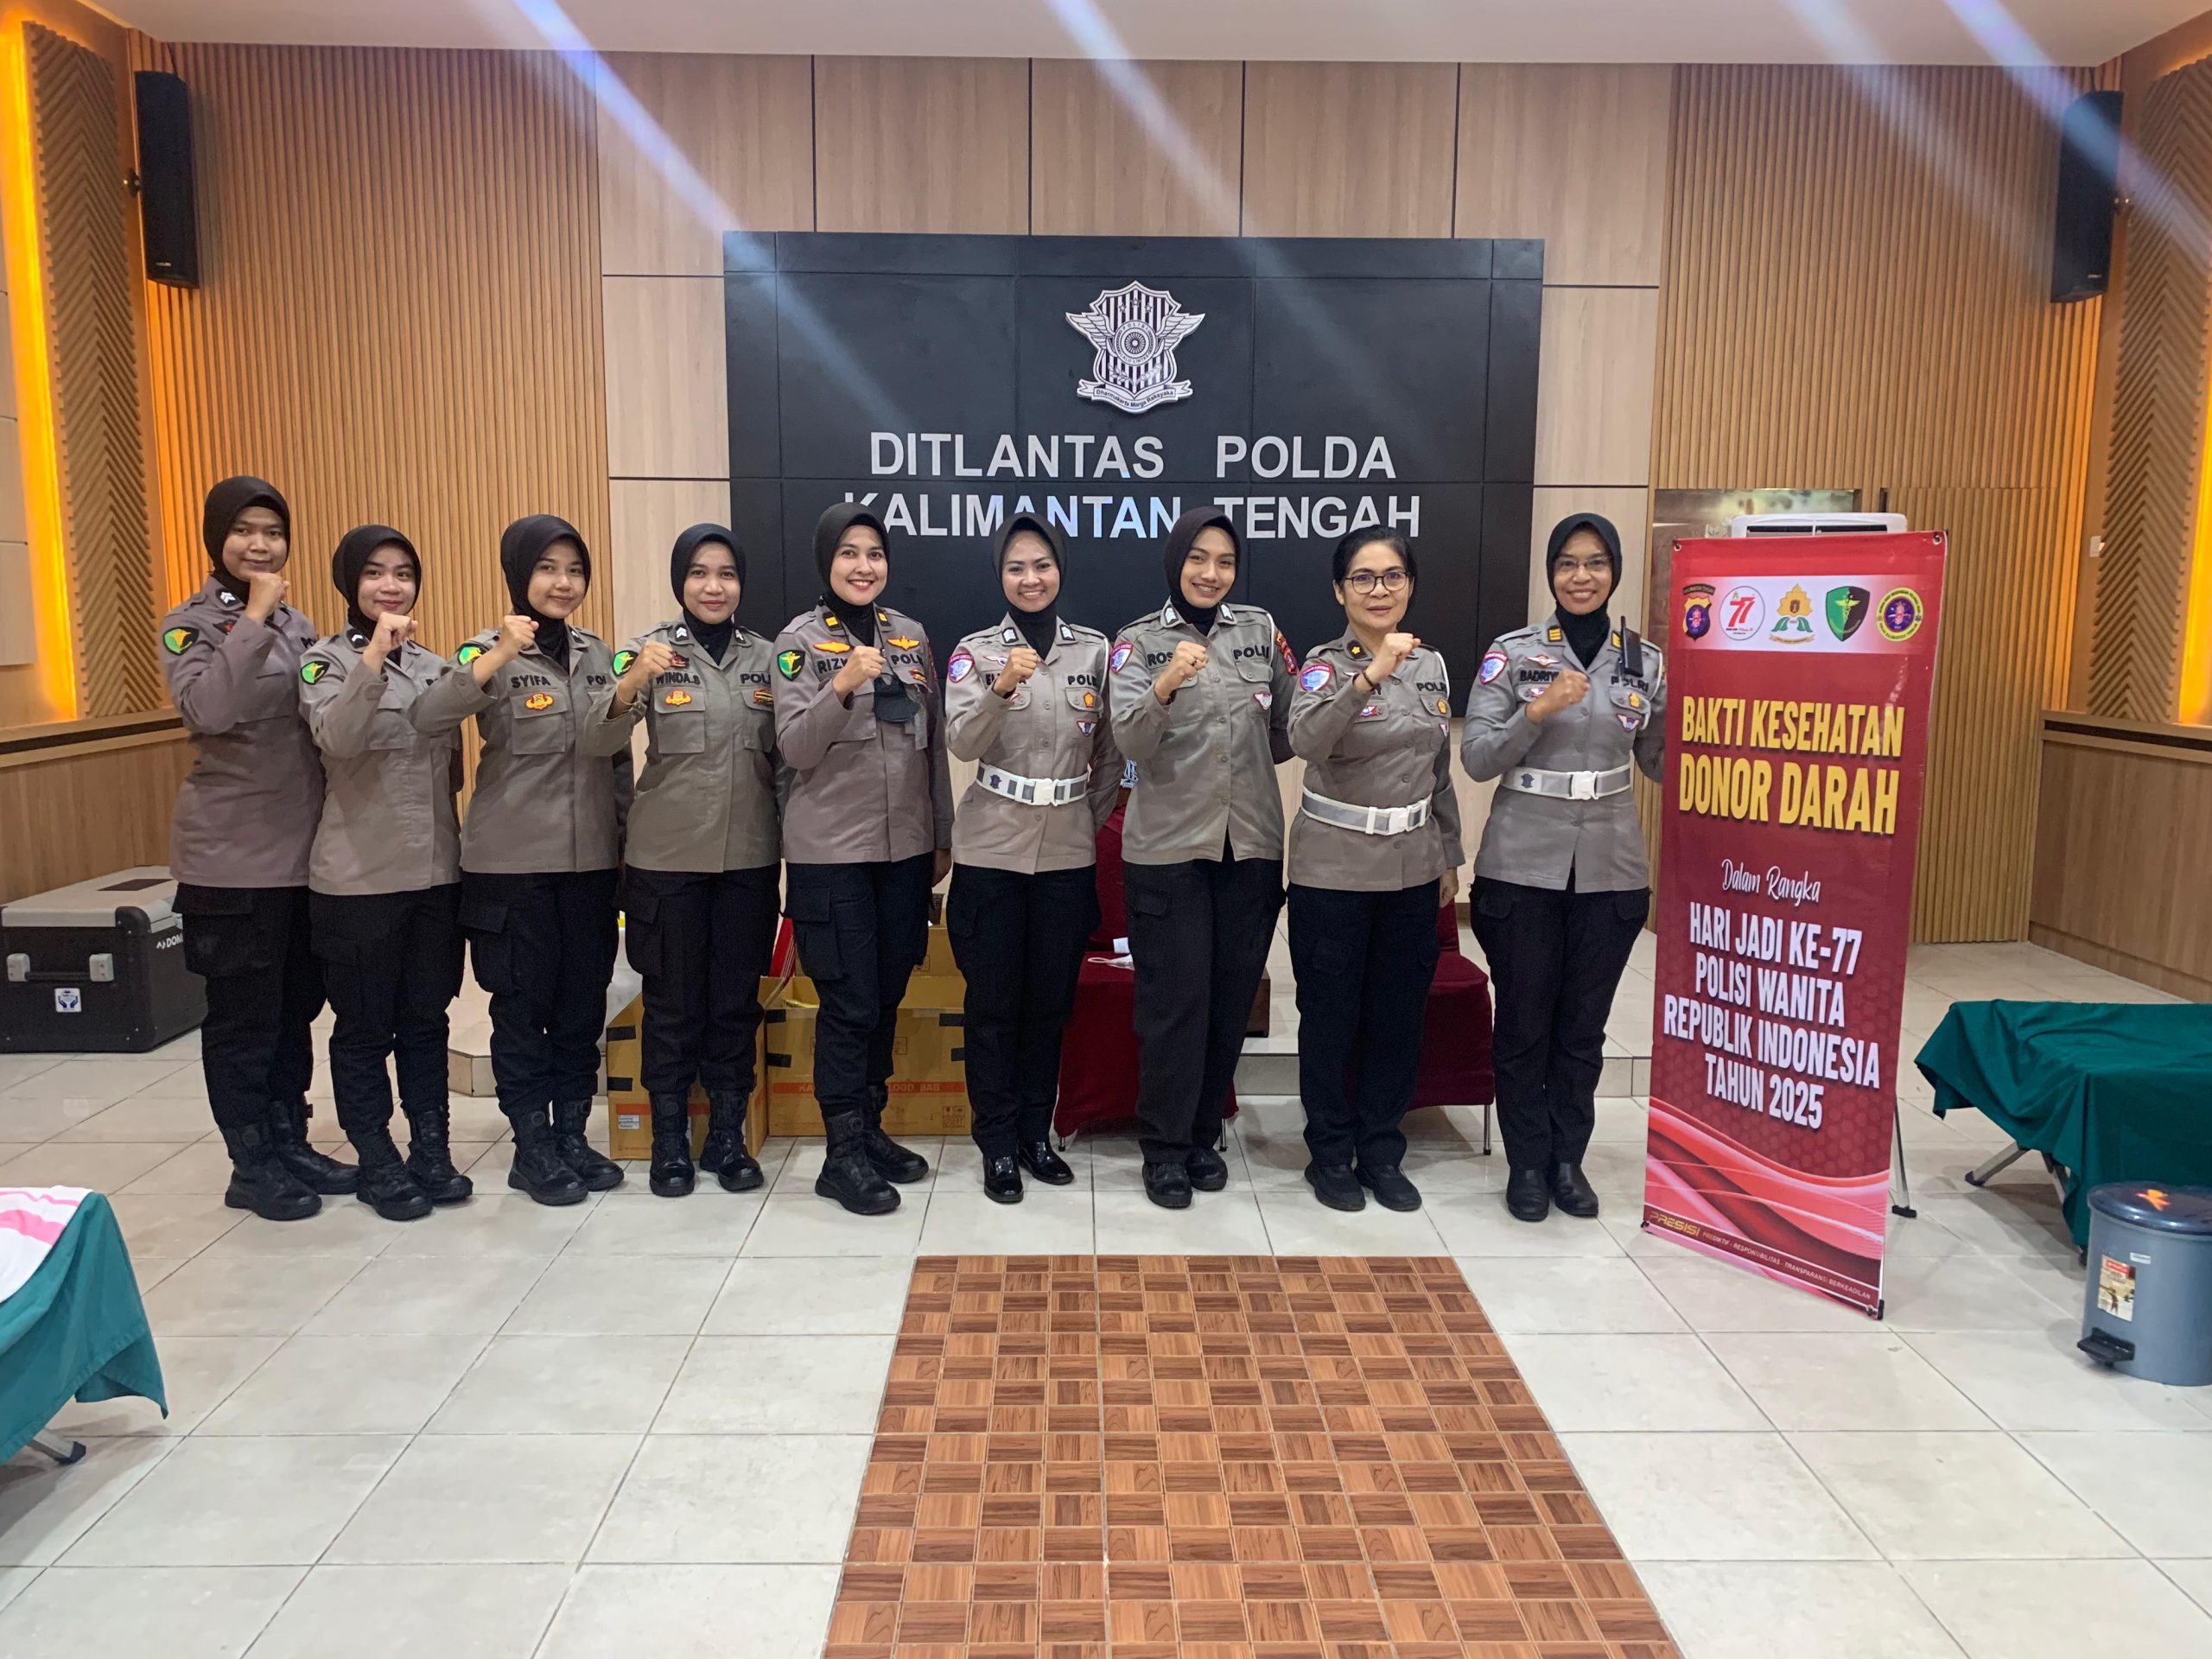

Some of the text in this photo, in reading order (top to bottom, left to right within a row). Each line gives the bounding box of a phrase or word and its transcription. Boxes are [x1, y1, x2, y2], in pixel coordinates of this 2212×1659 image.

[870, 431, 1396, 479] DITLANTAS POLDA
[1214, 495, 1420, 538] TENGAH
[1728, 596, 1755, 627] 77
[511, 674, 551, 688] SYIFA
[1681, 696, 1904, 757] BAKTI KESEHATAN
[1679, 753, 1899, 834] DONOR DARAH
[1721, 859, 1821, 906] Dalam Rangka
[1690, 901, 1862, 975] HARI JADI KE-77
[1695, 951, 1845, 1027] POLISI WANITA
[1663, 994, 1879, 1089] REPUBLIK INDONESIA
[887, 1083, 914, 1091] LOOD
[919, 1083, 940, 1091] BAG
[1705, 1052, 1824, 1128] TAHUN 2025
[1649, 1211, 1700, 1236] PRESISI
[1702, 1231, 1729, 1245] PREDIKTIF
[1828, 1280, 1871, 1300] BERKEADILAN
